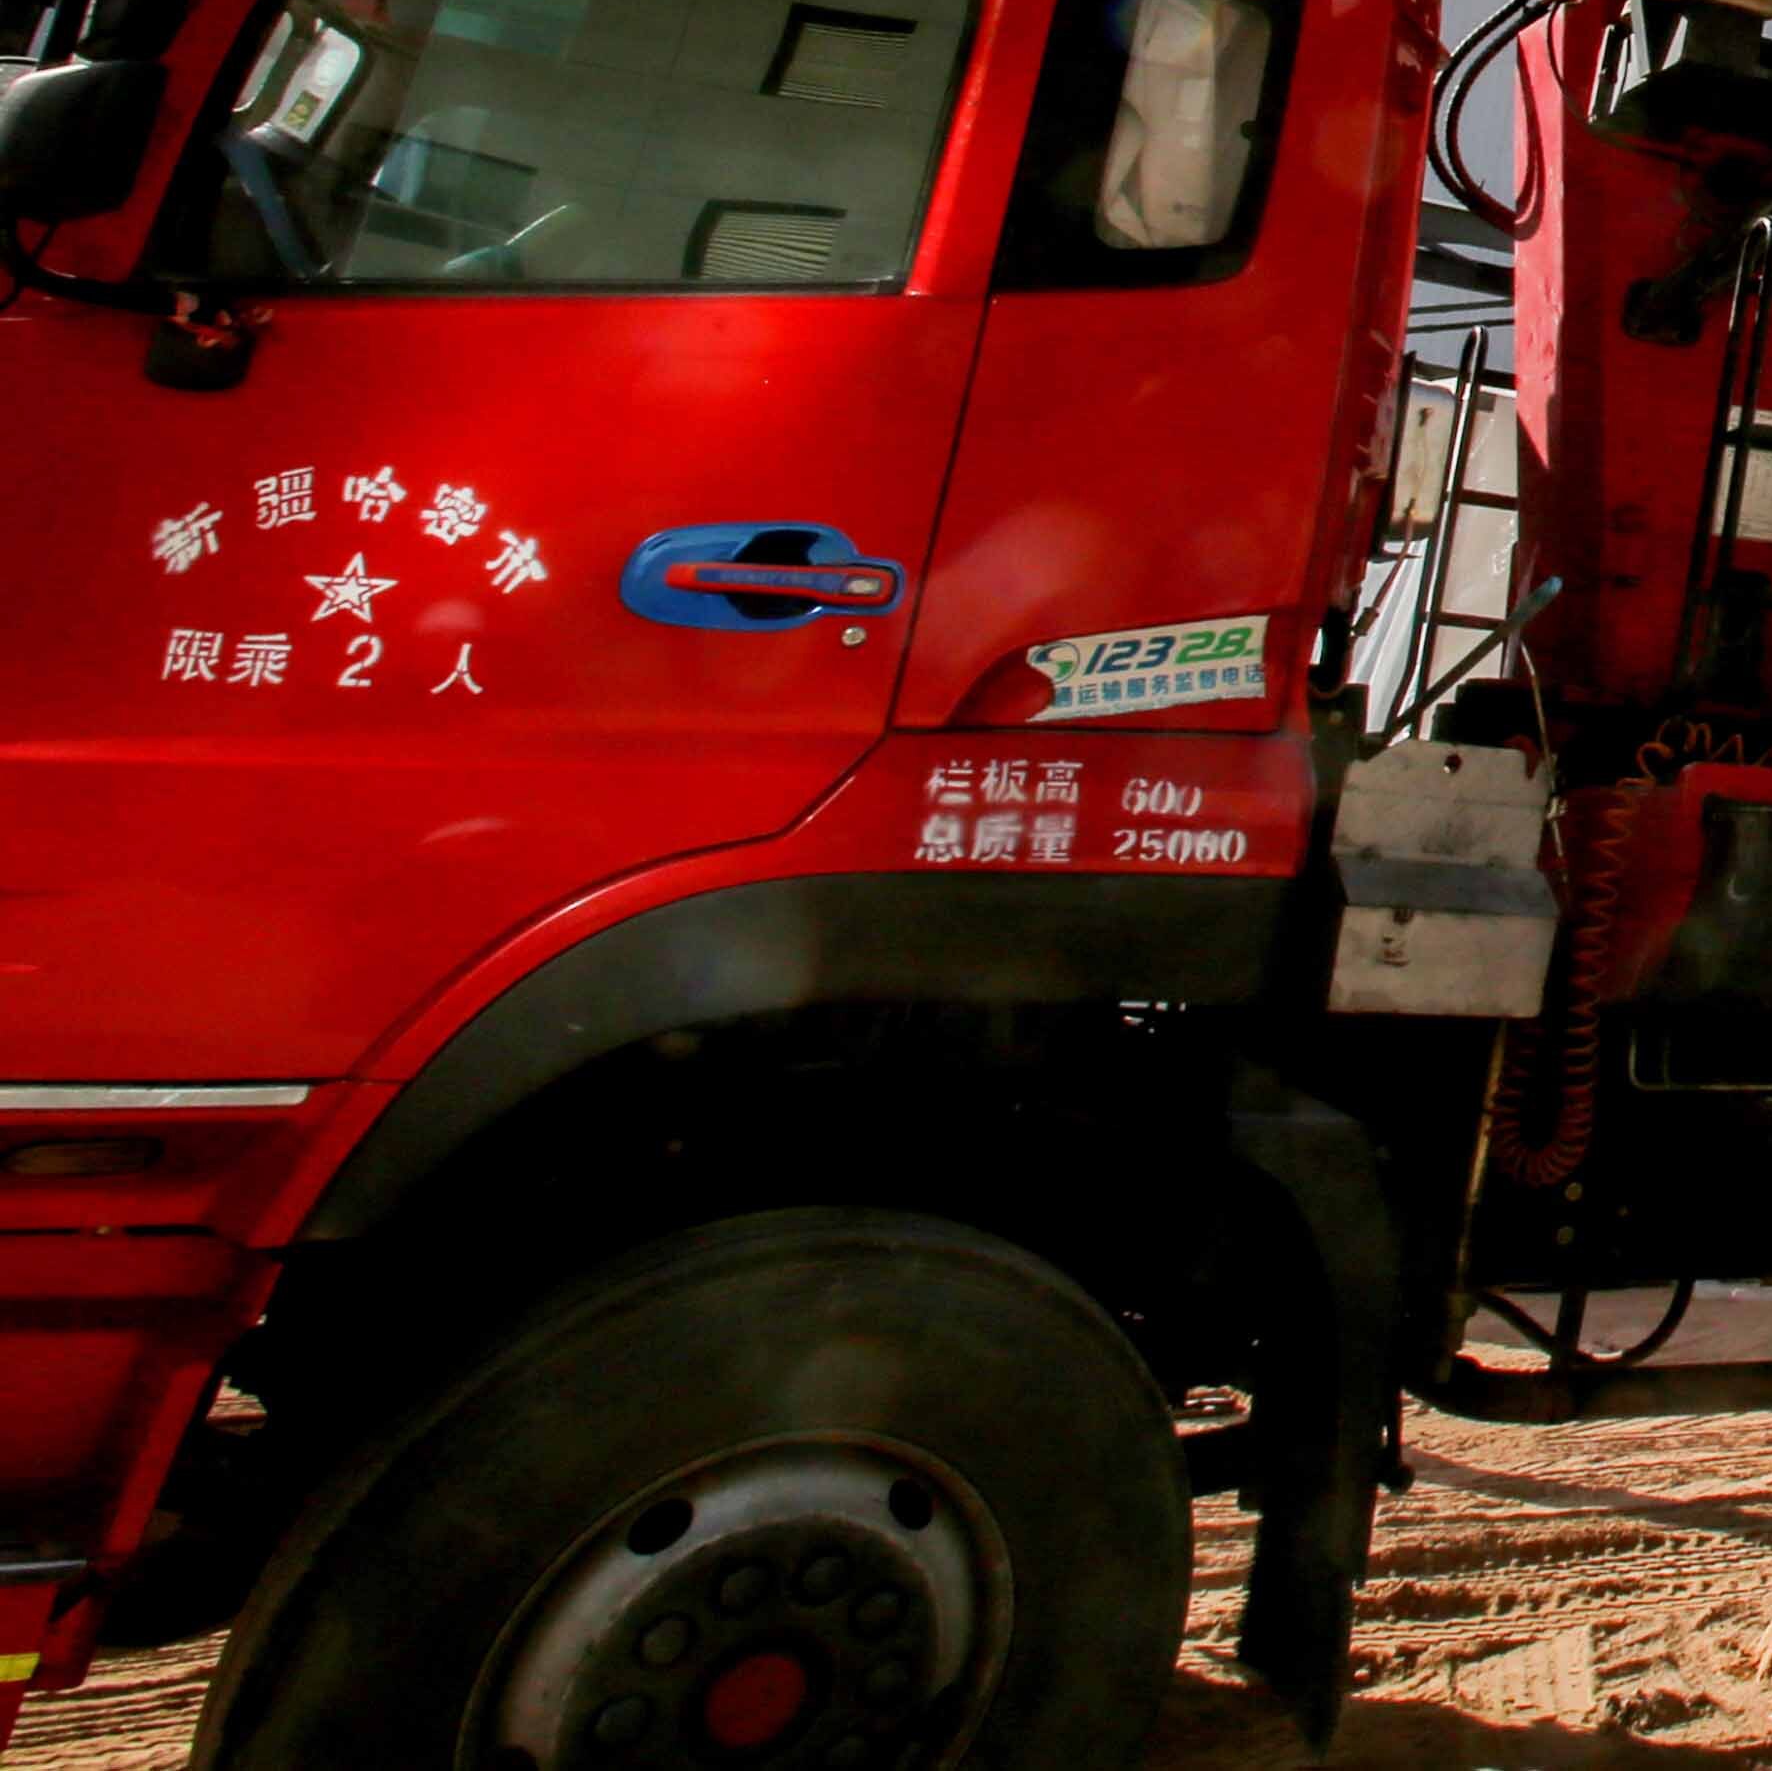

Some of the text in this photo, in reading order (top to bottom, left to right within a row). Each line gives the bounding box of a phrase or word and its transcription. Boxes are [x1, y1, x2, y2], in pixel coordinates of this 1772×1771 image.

[150, 464, 549, 595] 新疆哈密市
[1083, 626, 1256, 677] 12328
[926, 759, 1204, 817] 栏板高 600
[914, 813, 1078, 864] 总质量
